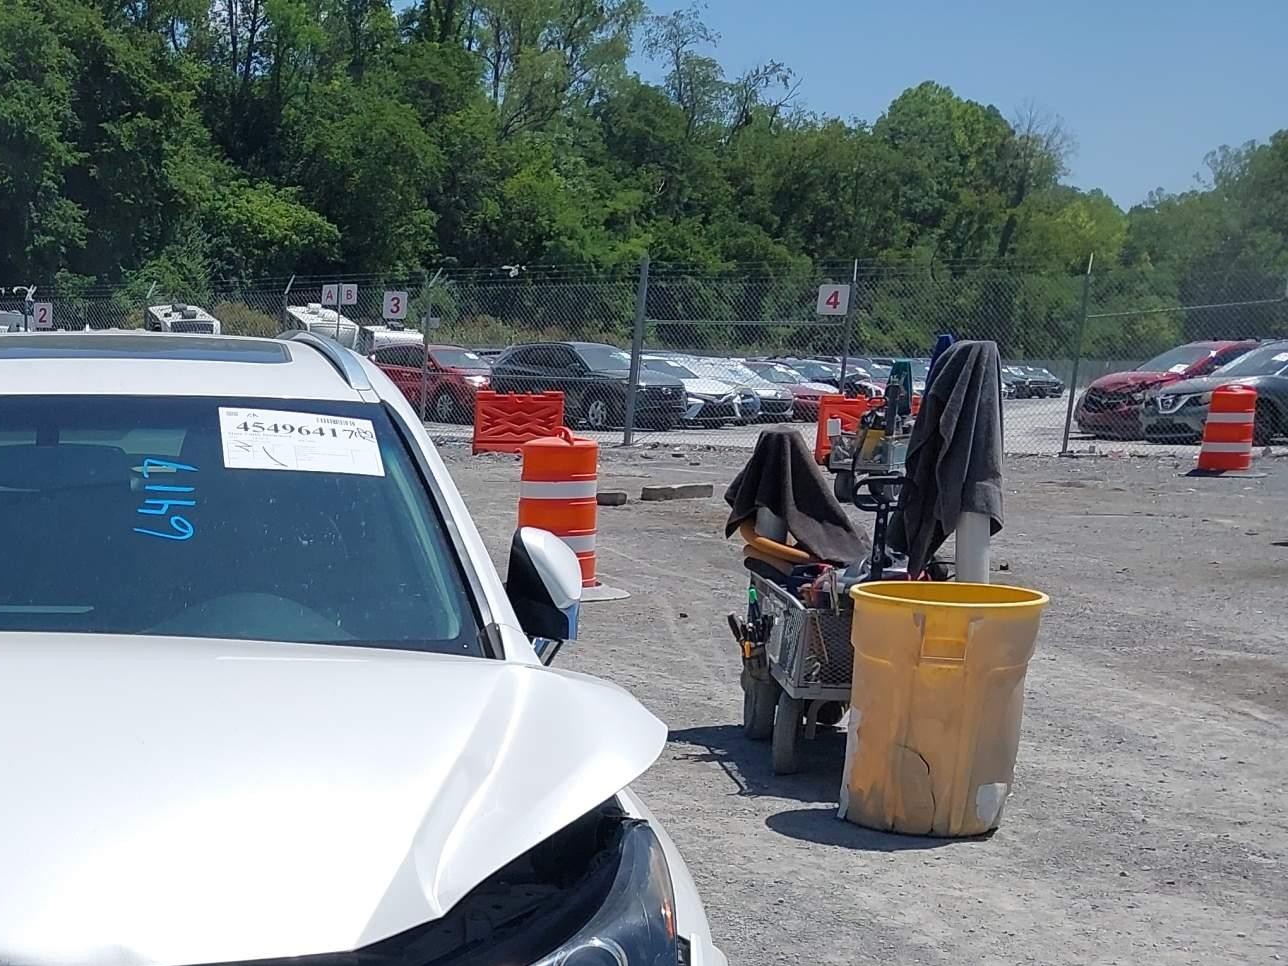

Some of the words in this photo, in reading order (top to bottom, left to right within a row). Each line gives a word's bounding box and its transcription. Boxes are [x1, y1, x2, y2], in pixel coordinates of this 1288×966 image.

[325, 289, 334, 303] A
[345, 289, 353, 301] B
[825, 290, 841, 310] 4
[389, 296, 401, 314] 3
[38, 307, 48, 324] 2
[235, 420, 355, 440] 45496417
[133, 458, 200, 540] 6417
